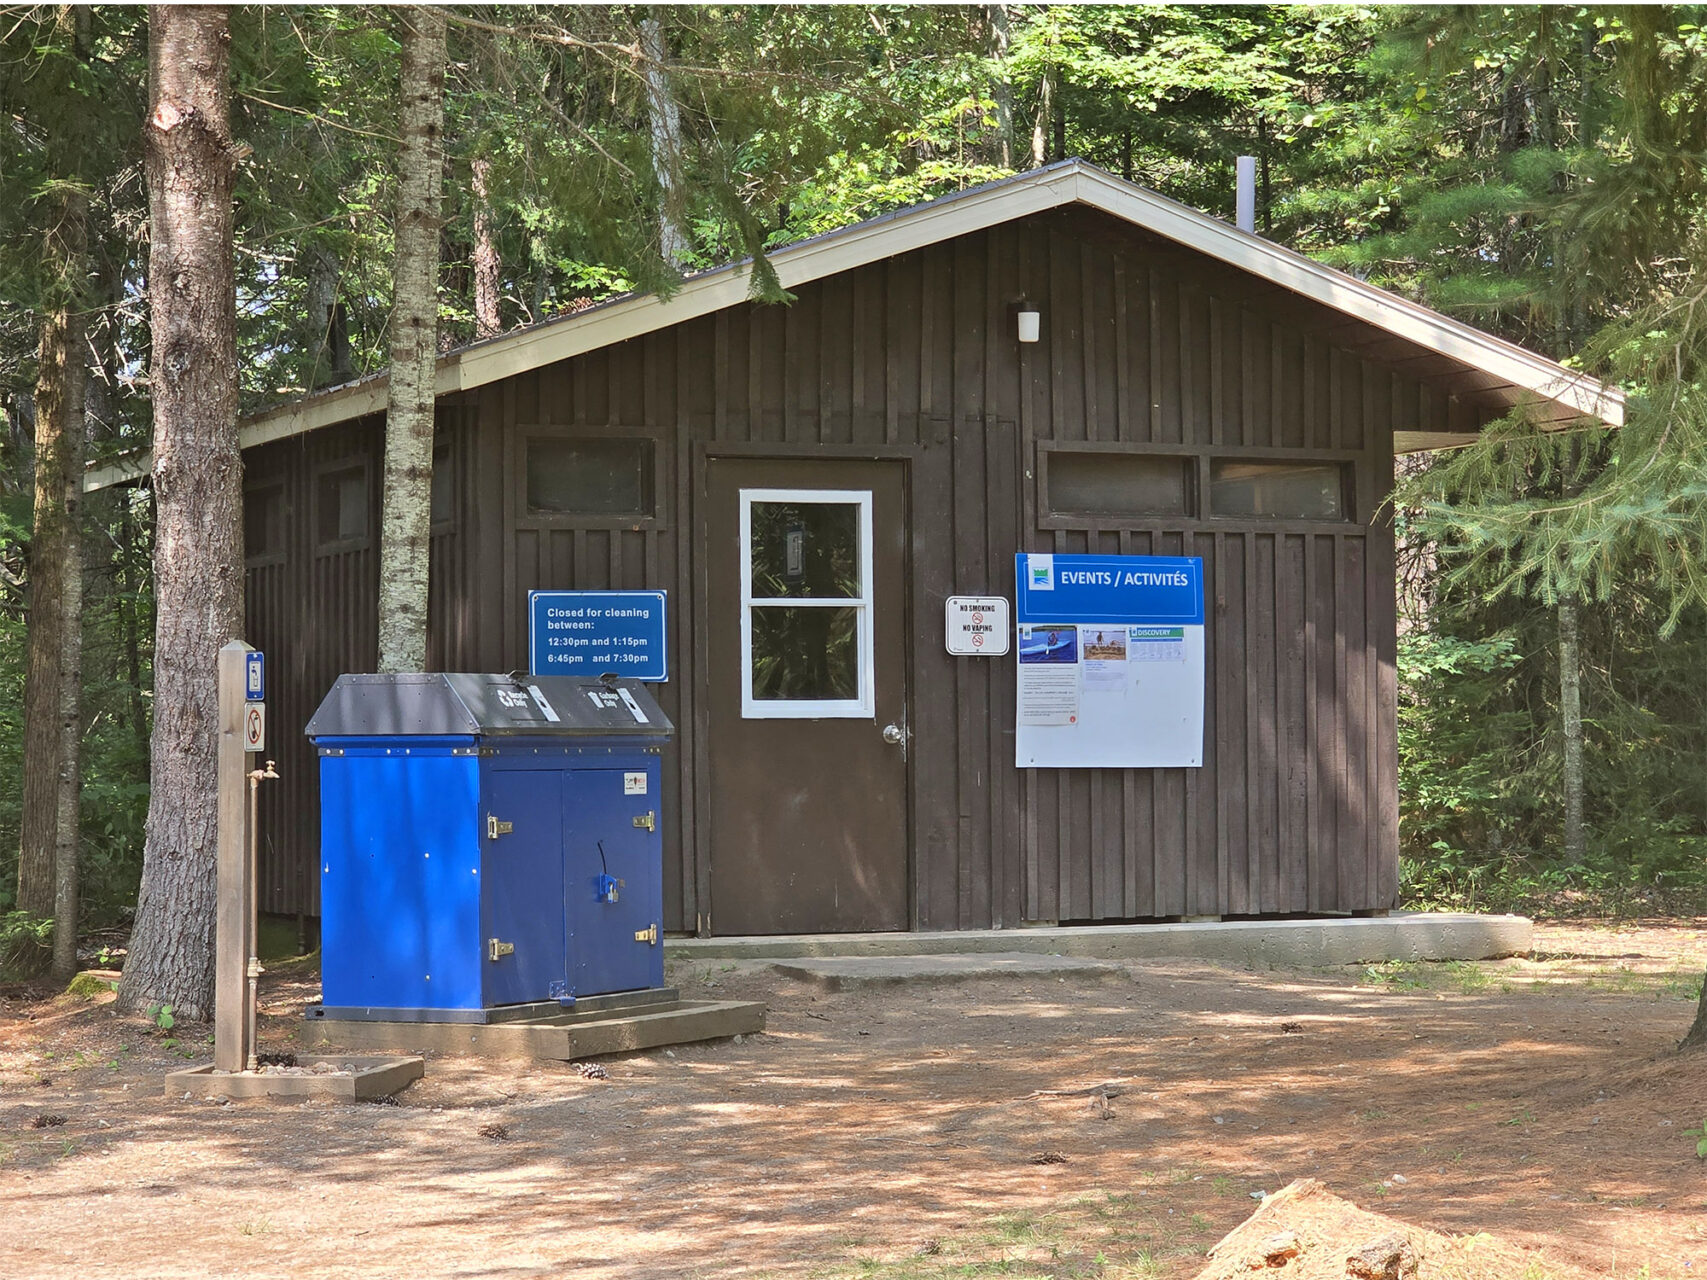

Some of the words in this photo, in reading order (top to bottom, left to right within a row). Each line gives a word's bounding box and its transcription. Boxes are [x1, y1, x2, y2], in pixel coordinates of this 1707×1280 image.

[1061, 571, 1111, 585] EVENTS
[1113, 571, 1122, 588] /
[1124, 570, 1189, 587] ACTIVITÉS
[547, 608, 584, 617] Closed
[587, 608, 603, 617] for
[605, 608, 649, 618] cleaning
[547, 621, 595, 629] between:
[548, 637, 589, 647] 12:30pm
[591, 637, 610, 646] and
[613, 637, 648, 646] 1:15pm
[547, 654, 583, 663] 6:45pm
[592, 654, 611, 663] and
[613, 654, 649, 663] 7:30pm
